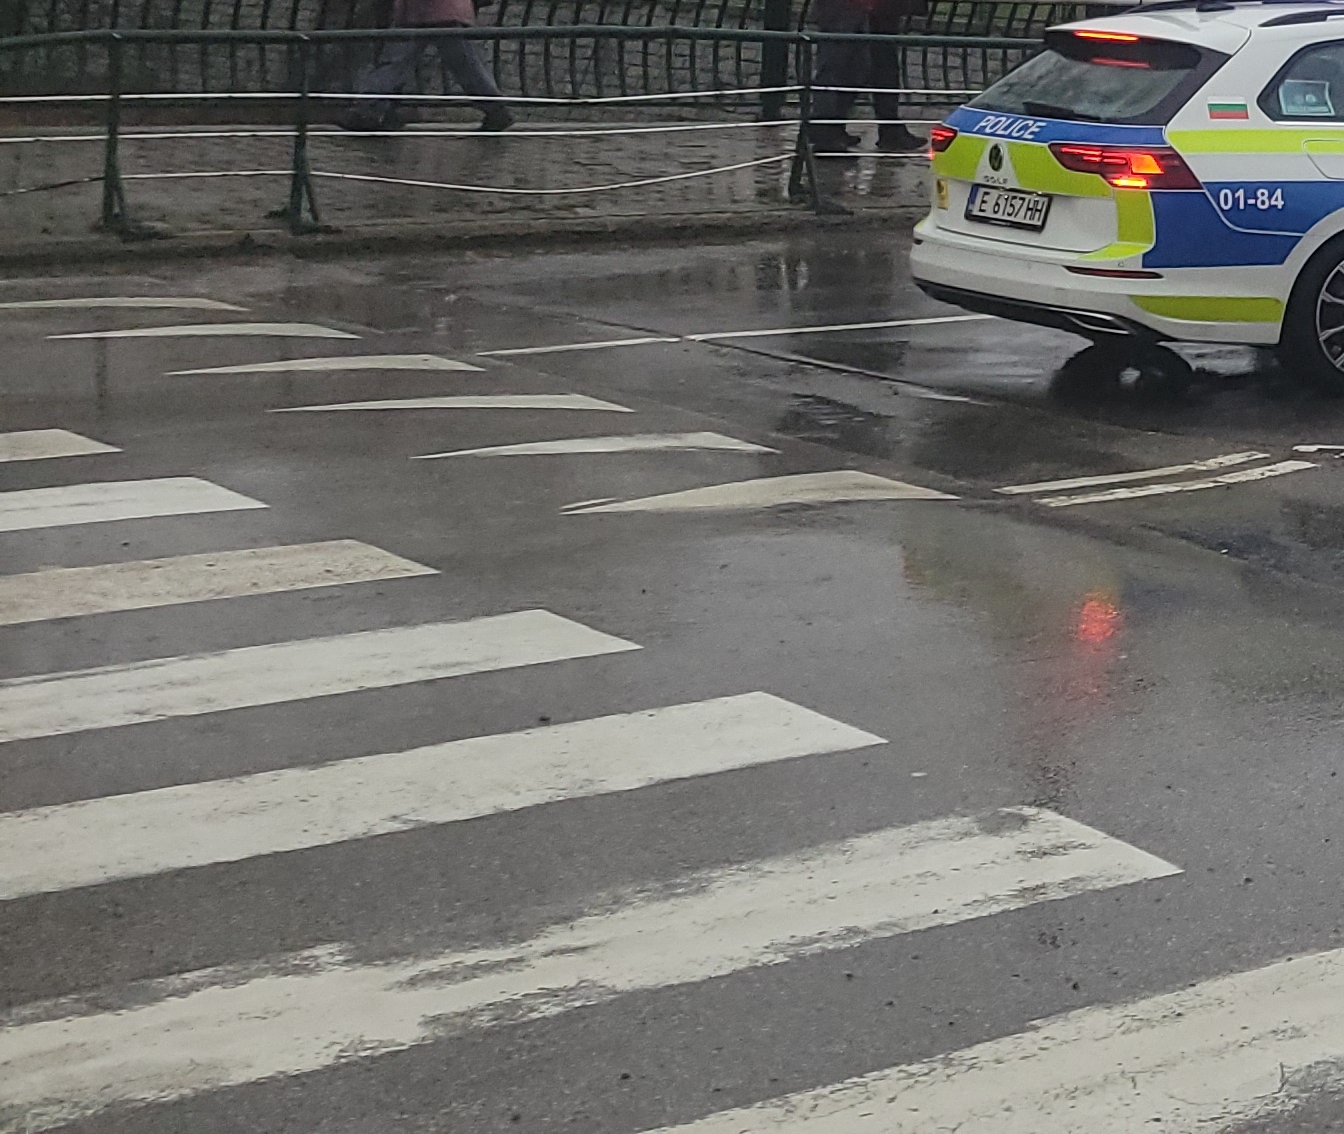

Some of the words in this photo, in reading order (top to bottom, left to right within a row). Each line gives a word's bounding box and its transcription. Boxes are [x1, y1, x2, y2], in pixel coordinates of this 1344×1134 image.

[972, 115, 1047, 140] POLICE
[978, 191, 991, 213] E
[992, 193, 1026, 219] 6157
[1024, 199, 1046, 224] HH
[1218, 187, 1285, 211] 01-84
